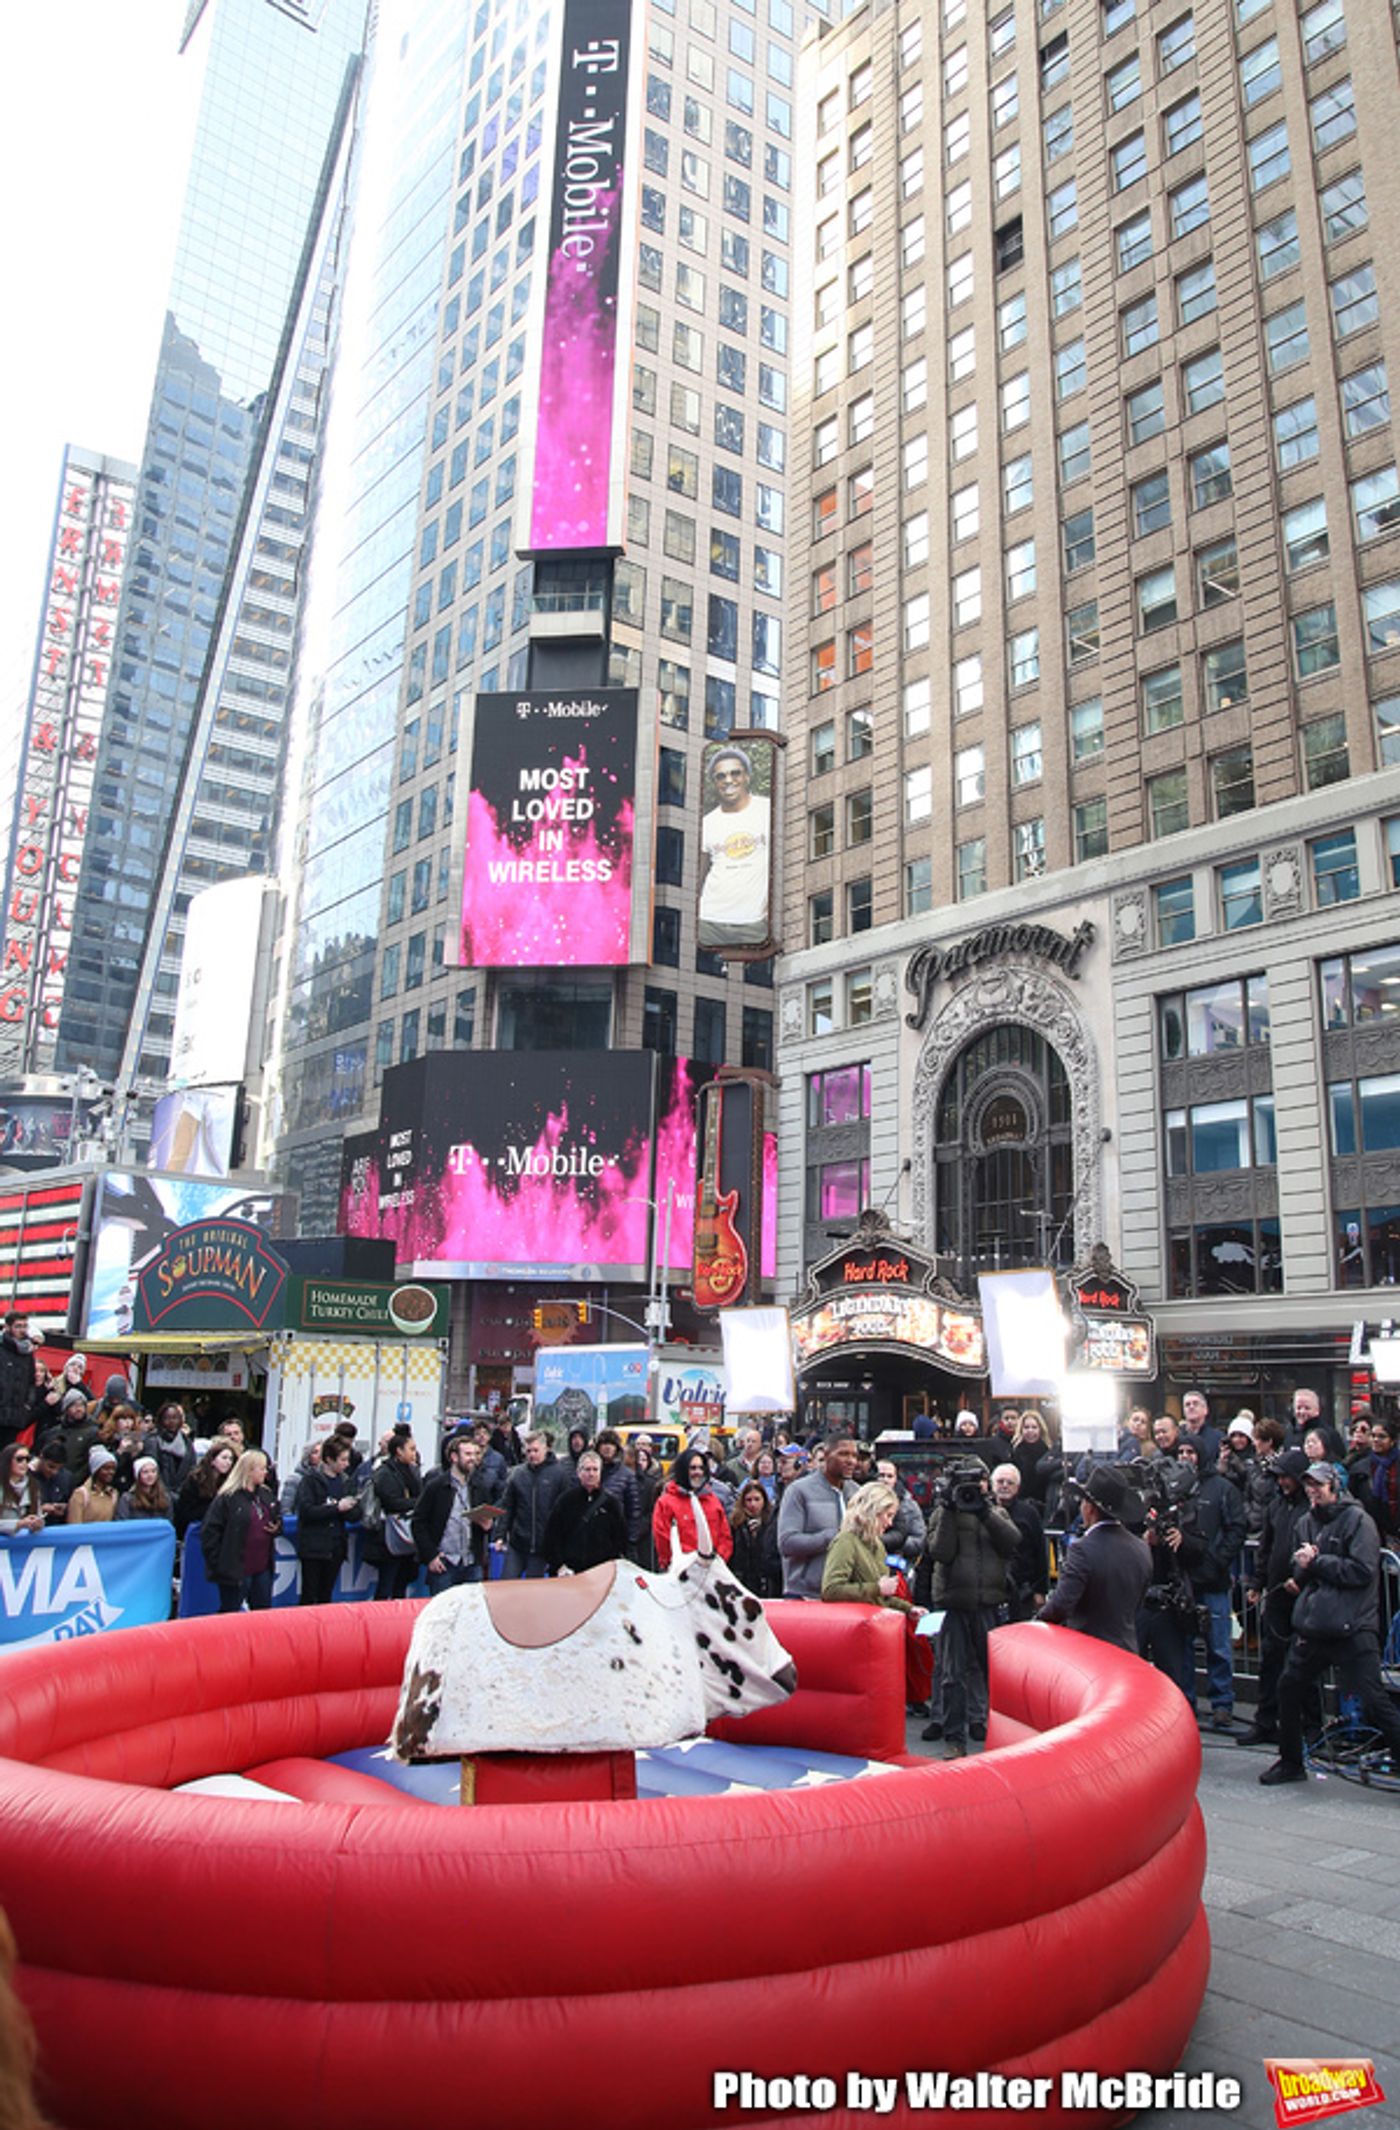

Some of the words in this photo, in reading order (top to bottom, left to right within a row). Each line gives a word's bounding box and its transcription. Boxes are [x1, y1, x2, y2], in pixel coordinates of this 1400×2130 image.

[46, 486, 86, 681] ERNST
[33, 721, 58, 750] &
[519, 767, 589, 791] MOST
[512, 797, 594, 822] LOVED
[539, 828, 564, 851] IN
[488, 859, 612, 884] WIRELESS
[0, 796, 48, 1022] YOUNG
[905, 920, 1096, 1030] Paramount
[157, 1245, 267, 1300] SOUPMAN
[843, 1260, 876, 1282] Hard
[877, 1257, 909, 1284] Rock
[53, 1600, 107, 1642] DAY
